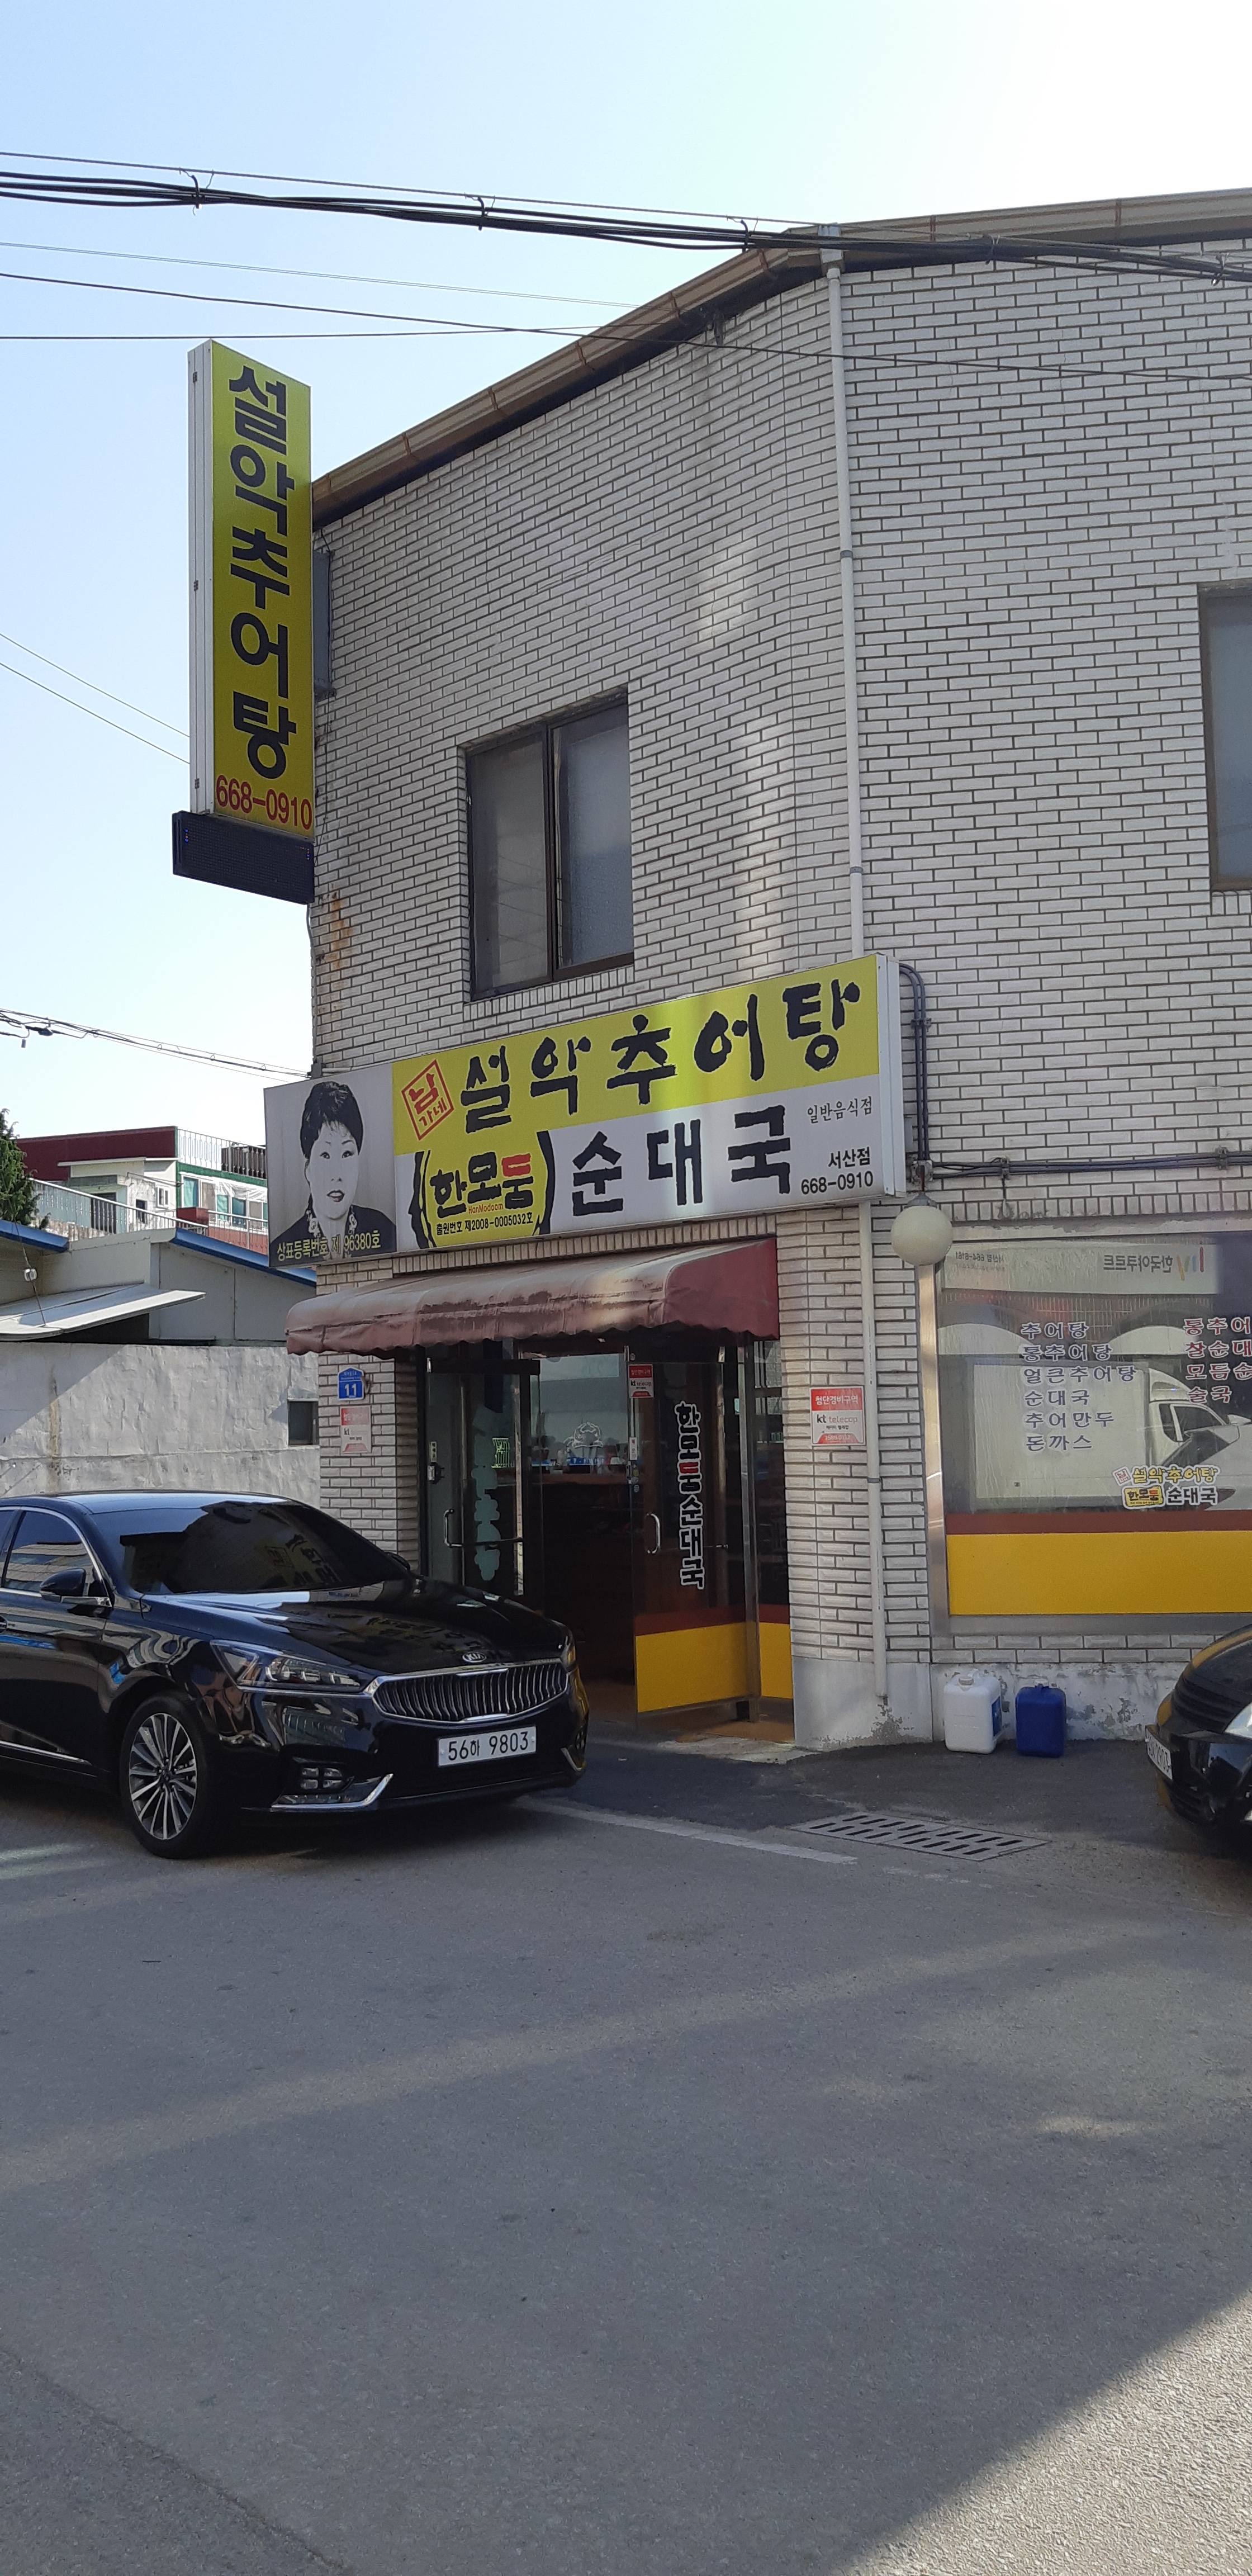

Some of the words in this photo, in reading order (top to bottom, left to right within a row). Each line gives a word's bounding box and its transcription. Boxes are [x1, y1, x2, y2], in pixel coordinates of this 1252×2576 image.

[229, 364, 297, 780] 설악추어탕
[216, 774, 312, 831] 668-0910
[461, 979, 860, 1134] 설악추어탕
[807, 1096, 873, 1124] 일반음식점
[430, 1152, 534, 1218] 한모둠
[572, 1105, 791, 1216] 순대국
[828, 1147, 871, 1170] 서산점
[801, 1171, 874, 1195] 668-0910
[437, 1221, 463, 1235] 출원번호
[277, 1236, 330, 1262] 상표등록번호
[1021, 1322, 1089, 1339] 추어탕
[1183, 1317, 1251, 1336] 통추어
[1022, 1344, 1112, 1362] 통추어탕
[1185, 1339, 1252, 1358] 찰순대
[1024, 1365, 1137, 1384] 얼큰추어탕
[344, 1383, 357, 1396] 11
[1025, 1390, 1090, 1407] 순대국
[1188, 1385, 1232, 1404] 술국
[815, 1395, 858, 1405] 첨단경비구역
[817, 1414, 827, 1423] kt
[828, 1415, 858, 1424] telecop
[1025, 1412, 1115, 1429] 추어만두
[1026, 1434, 1093, 1452] 돈까스
[1132, 1467, 1218, 1484] 설악추어탕
[675, 1401, 704, 1589] 한모둠순대국
[1168, 1486, 1216, 1504] 순대국
[448, 1739, 480, 1761] 56하
[489, 1731, 528, 1755] 9803
